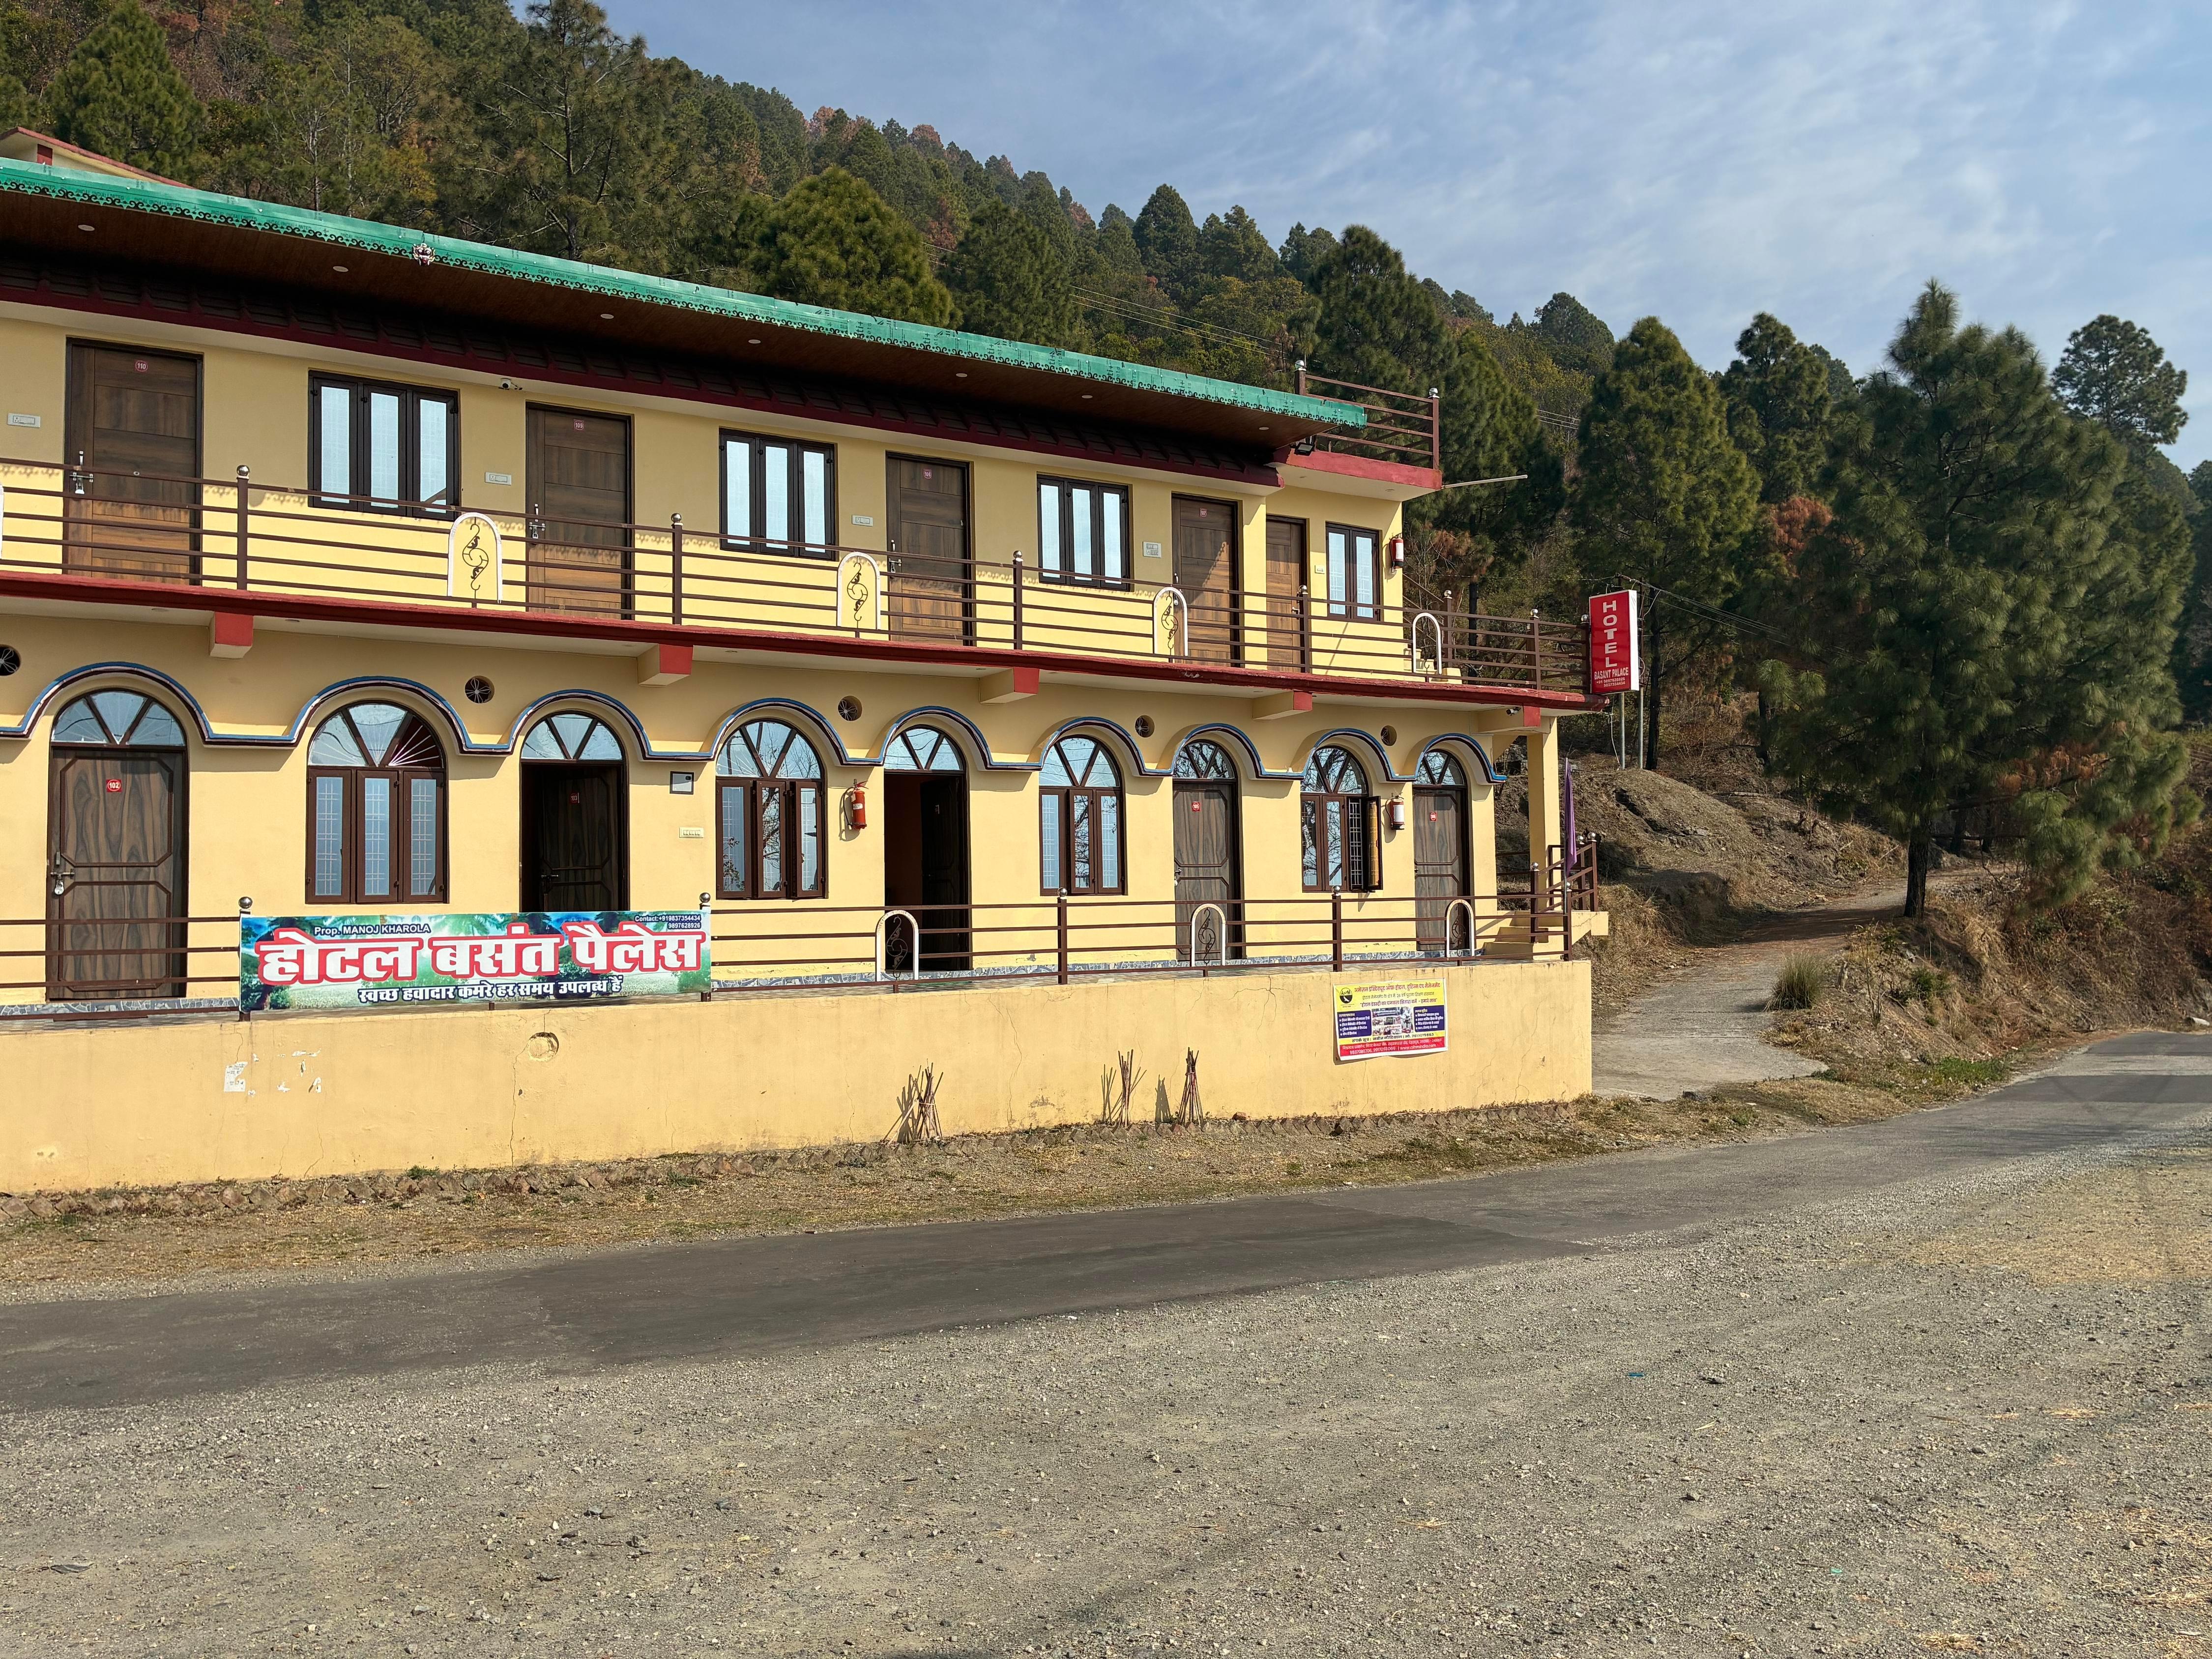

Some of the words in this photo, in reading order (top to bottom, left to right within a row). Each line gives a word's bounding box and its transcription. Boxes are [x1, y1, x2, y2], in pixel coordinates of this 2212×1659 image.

[1602, 600, 1617, 668] HOTEL
[1594, 669, 1611, 680] BASANT
[1612, 667, 1629, 677] PALACE
[314, 927, 340, 936] Prop.
[343, 925, 379, 934] MANOJ
[381, 924, 430, 933] KHAROLA
[258, 930, 420, 983] होटल
[431, 924, 562, 976] बसंत
[565, 923, 703, 972] पैलेस
[359, 988, 399, 1002] स्वच्छ
[402, 986, 456, 1000] हवादार
[458, 982, 494, 998] कमरे
[496, 983, 516, 996] हर
[518, 982, 555, 995] समय
[558, 980, 608, 994] उपलब्ध
[609, 976, 623, 992] हैं
